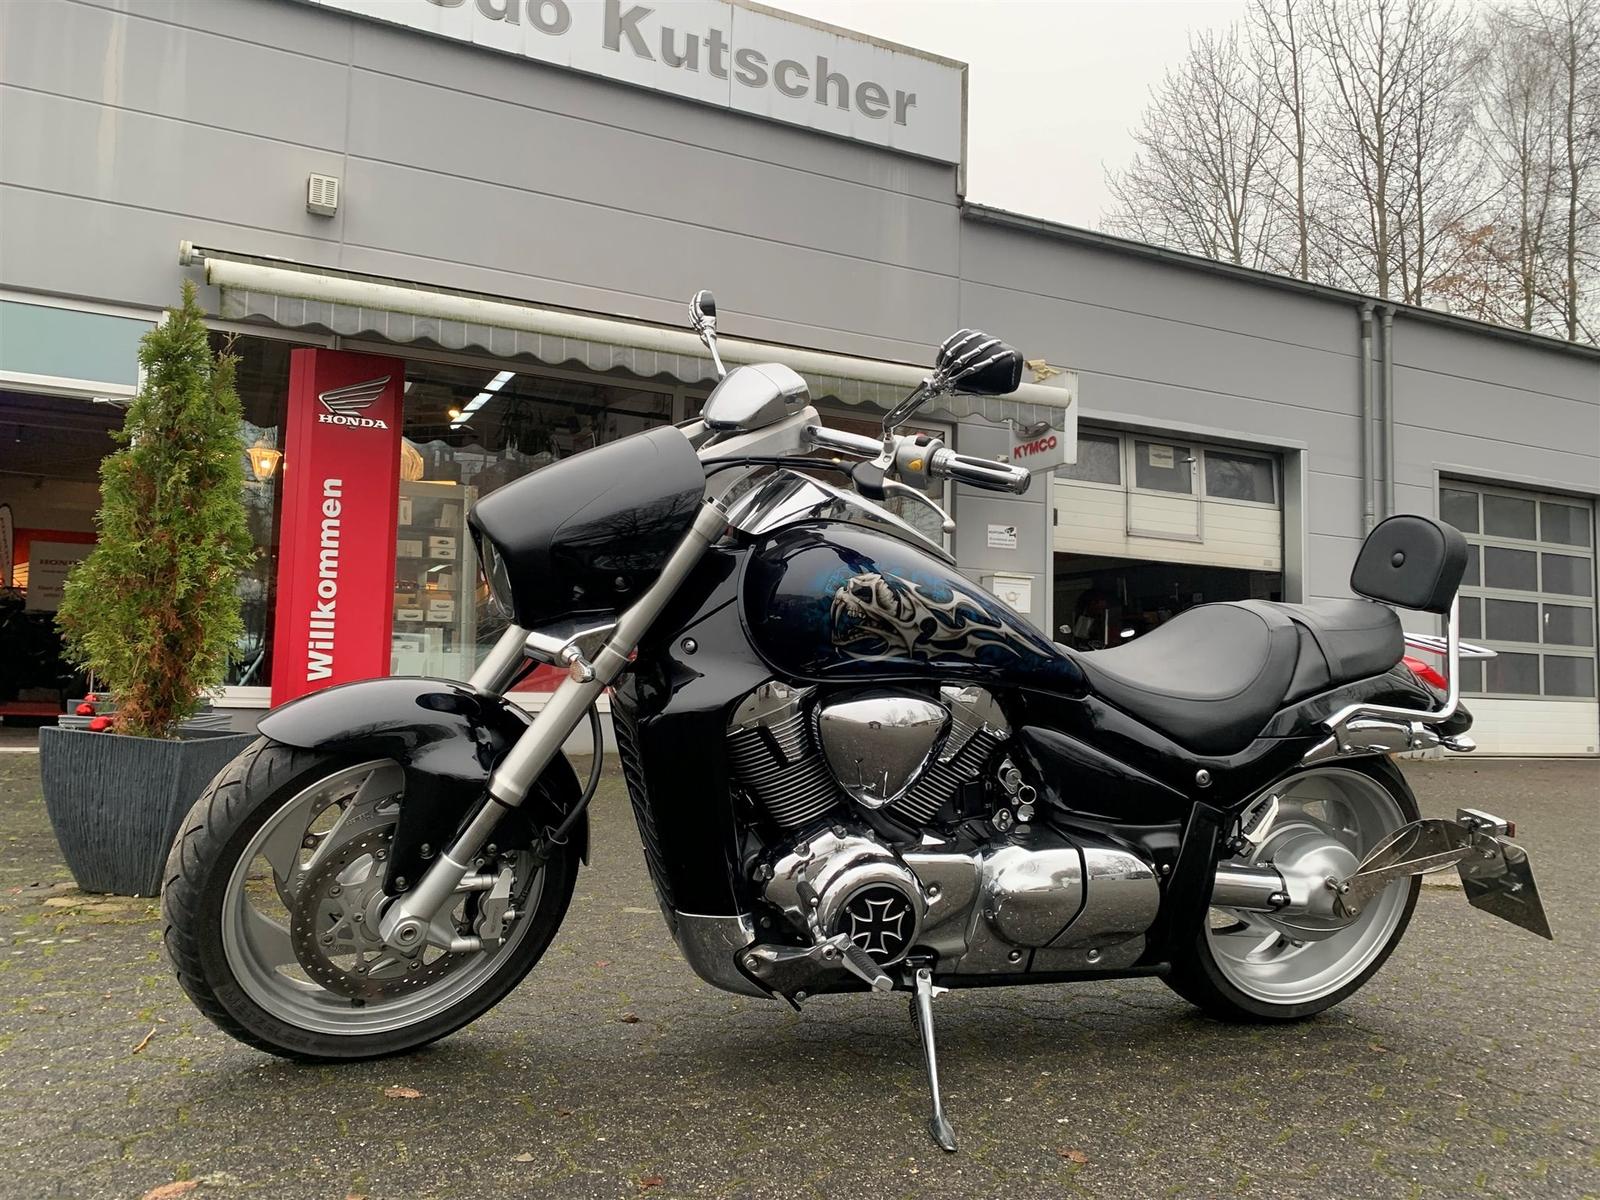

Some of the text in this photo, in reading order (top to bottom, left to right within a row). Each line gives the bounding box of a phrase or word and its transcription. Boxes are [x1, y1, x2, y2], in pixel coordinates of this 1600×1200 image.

[601, 0, 918, 127] Kutscher
[318, 413, 389, 430] HONDA
[1013, 435, 1057, 460] KYMCO
[307, 478, 343, 682] Willkommen
